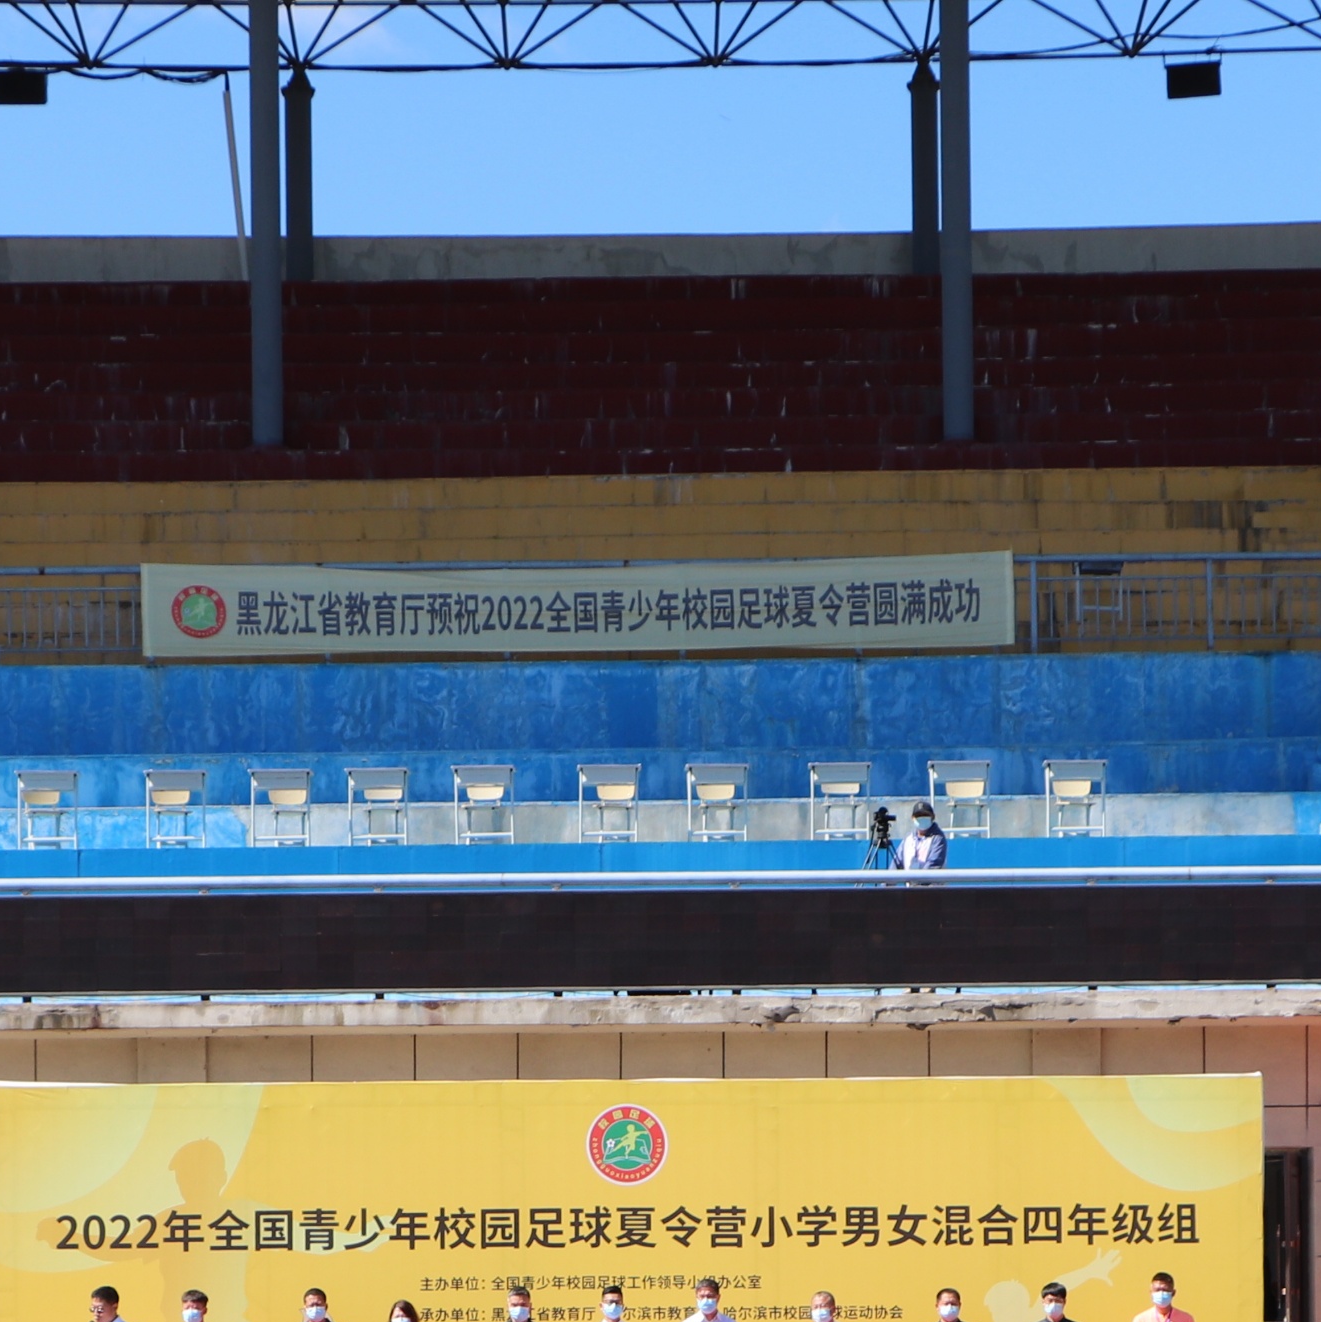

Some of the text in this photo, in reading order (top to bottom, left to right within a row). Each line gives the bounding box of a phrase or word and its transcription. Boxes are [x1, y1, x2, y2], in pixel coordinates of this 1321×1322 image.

[236, 582, 981, 636] 黑龙江省教育厅预祝2022全国青少年校园足球夏令营圆满成功
[56, 1203, 1200, 1252] 2022年全国青少年校园足球夏令营小学男女混合四年级组
[723, 1305, 903, 1321] 哈尔滨市校园球运动协会
